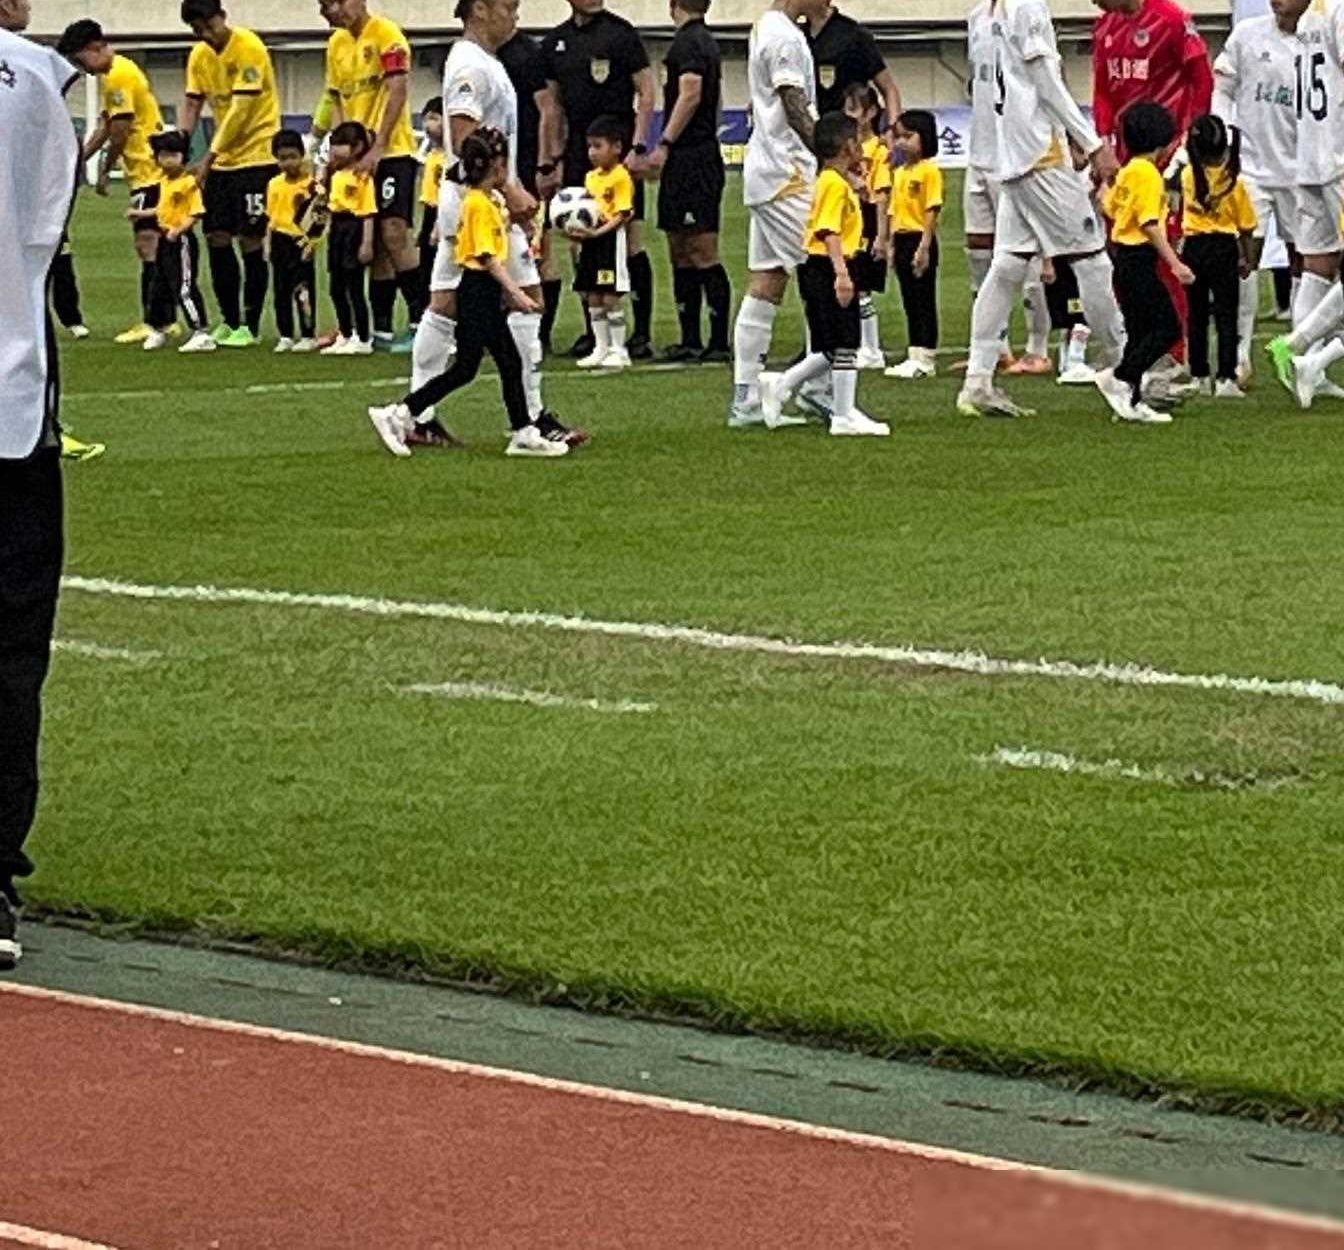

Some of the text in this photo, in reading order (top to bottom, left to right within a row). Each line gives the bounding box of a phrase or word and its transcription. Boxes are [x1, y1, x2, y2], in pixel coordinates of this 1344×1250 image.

[1294, 52, 1329, 121] 15
[382, 177, 395, 200] 6
[245, 193, 264, 216] 15
